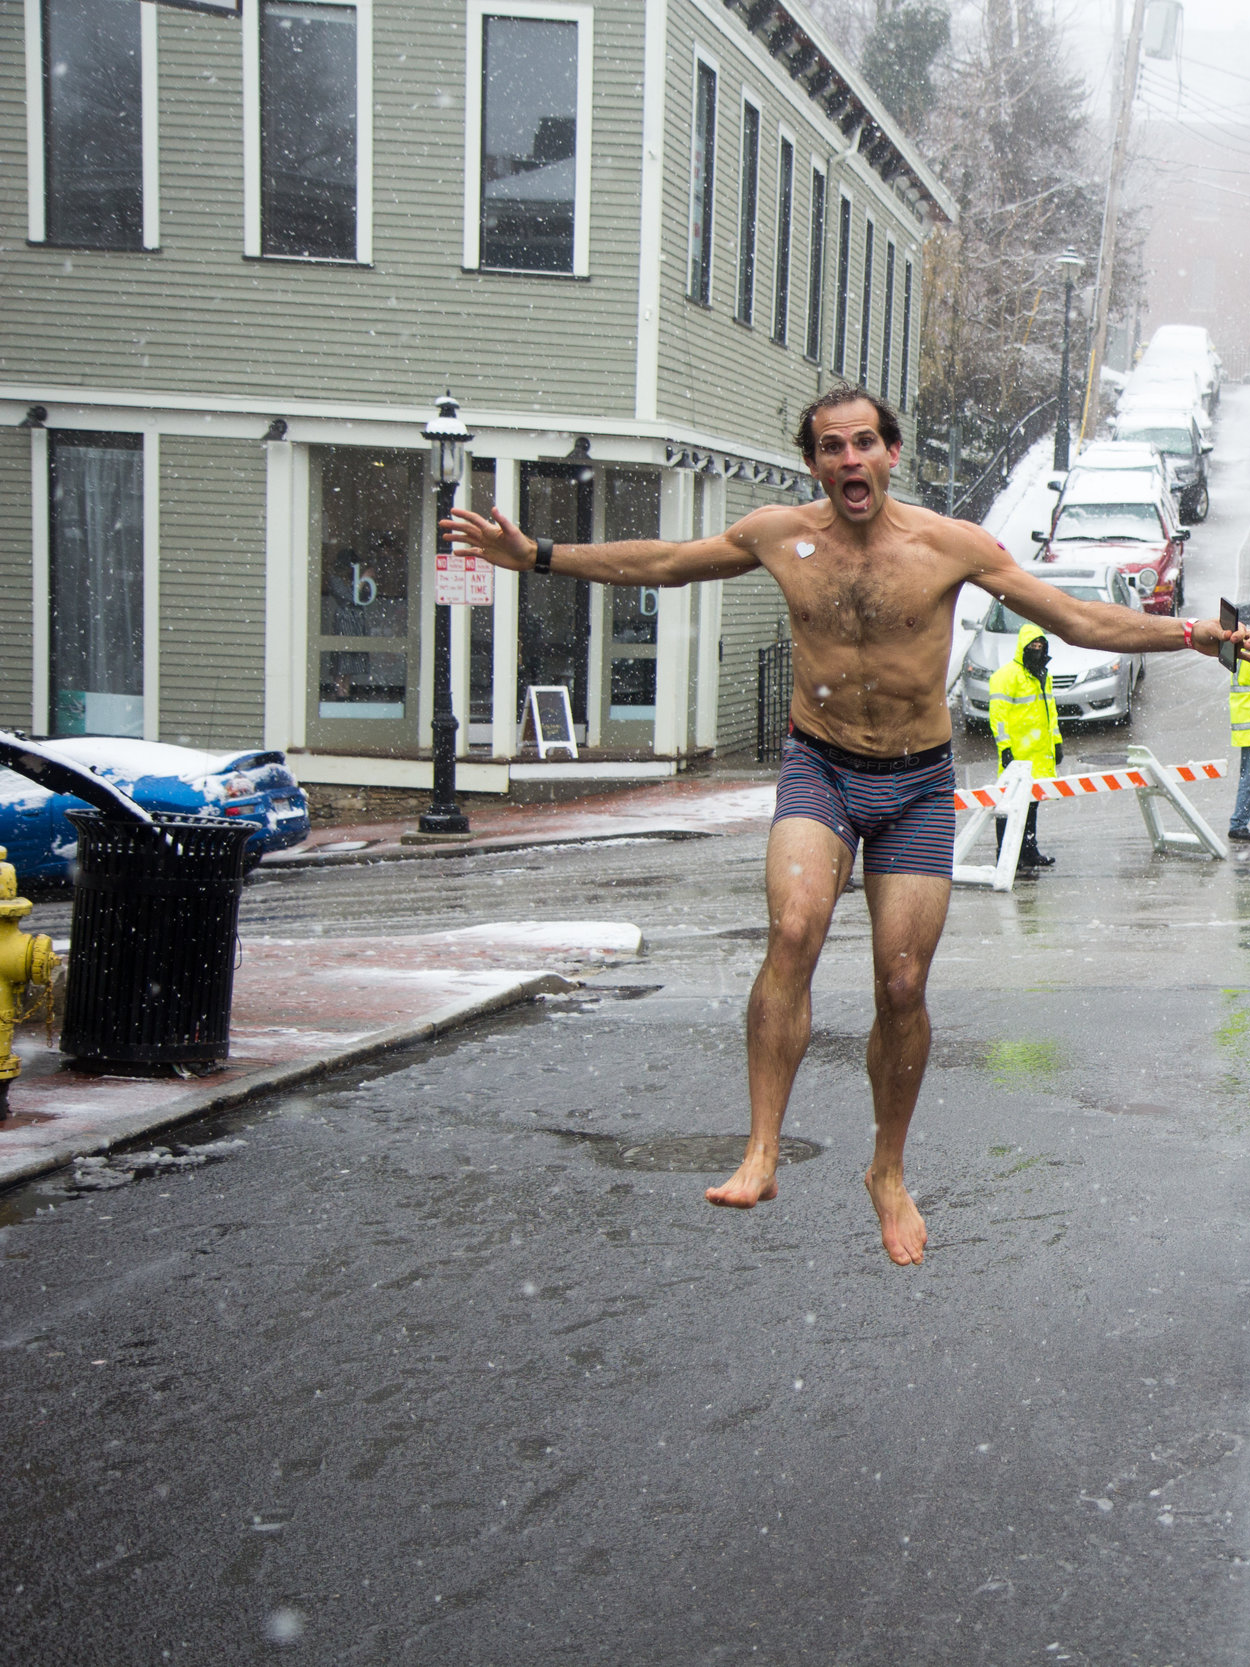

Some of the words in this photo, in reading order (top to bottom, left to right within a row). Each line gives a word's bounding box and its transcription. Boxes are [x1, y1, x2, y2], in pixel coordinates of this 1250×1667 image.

[437, 558, 447, 569] NO
[466, 559, 475, 569] NO
[472, 574, 486, 582] ANY
[351, 562, 377, 606] b
[471, 585, 487, 595] TIME
